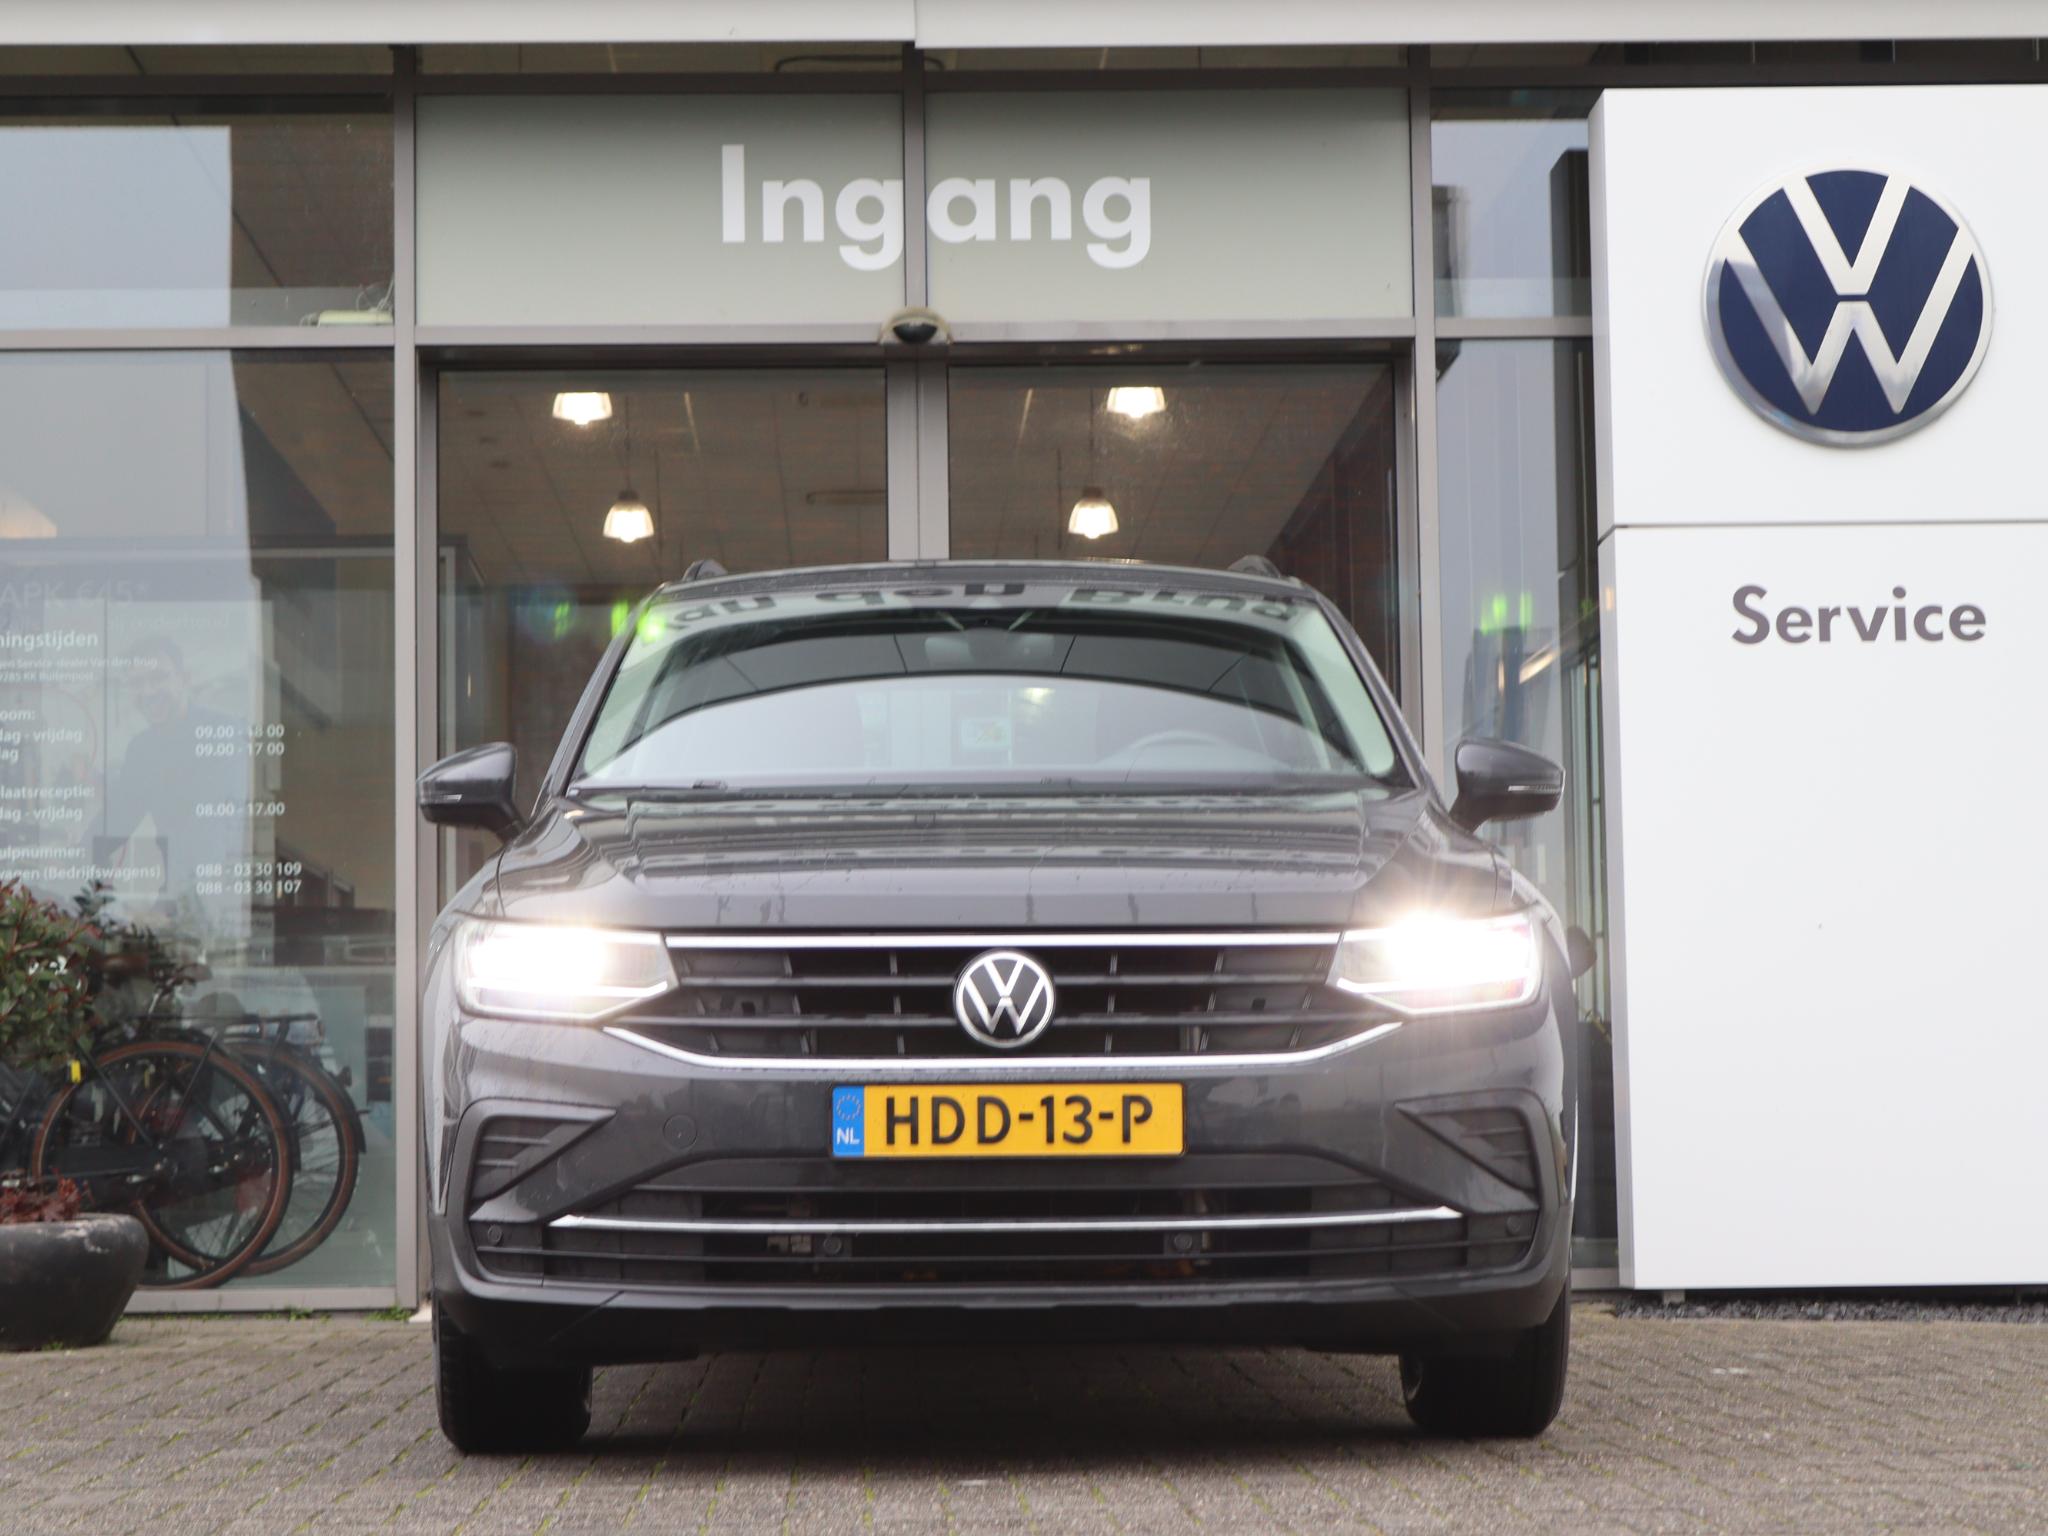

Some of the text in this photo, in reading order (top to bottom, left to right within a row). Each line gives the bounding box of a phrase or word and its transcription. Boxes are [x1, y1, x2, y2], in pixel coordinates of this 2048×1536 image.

[721, 143, 1151, 271] Ingang
[1731, 584, 1986, 644] Service
[33, 728, 82, 744] vrijdag
[195, 725, 234, 738] 09.00
[247, 723, 285, 738] 1800
[0, 746, 18, 765] ag
[195, 742, 234, 756] 09.00
[247, 741, 285, 756] 1700
[33, 805, 83, 822] vrijdag
[195, 803, 234, 816] 08.00
[247, 801, 286, 816] 17.00
[196, 863, 222, 877] 088
[234, 862, 251, 876] 03
[255, 862, 273, 876] 30
[276, 861, 302, 876] 109
[196, 881, 222, 895] 088
[234, 880, 251, 894] 03
[255, 880, 273, 894] 30
[276, 879, 302, 895] 107
[885, 1094, 1153, 1146] HDD-13-P
[836, 1127, 860, 1145] NL
